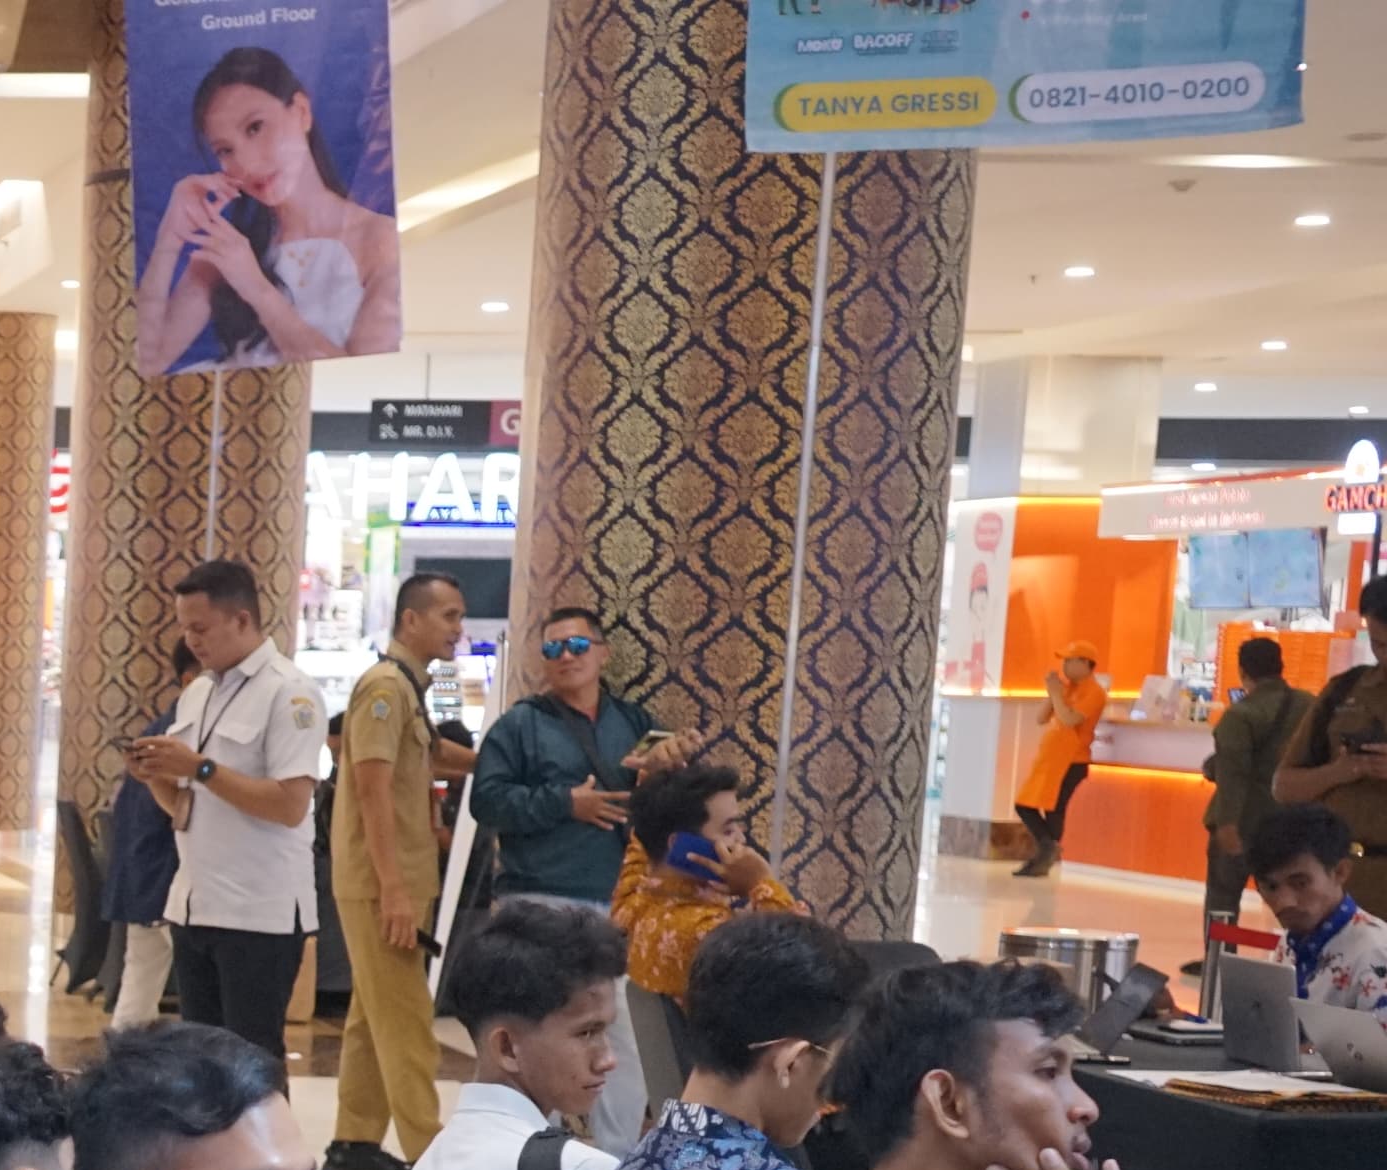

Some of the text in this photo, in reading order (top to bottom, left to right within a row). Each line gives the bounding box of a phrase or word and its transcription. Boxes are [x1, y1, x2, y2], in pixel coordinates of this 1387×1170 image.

[201, 7, 317, 30] Ground Floor
[798, 92, 980, 116] TANYA GRESSI
[1029, 77, 1250, 108] 0821-4010-0200
[500, 408, 521, 435] G
